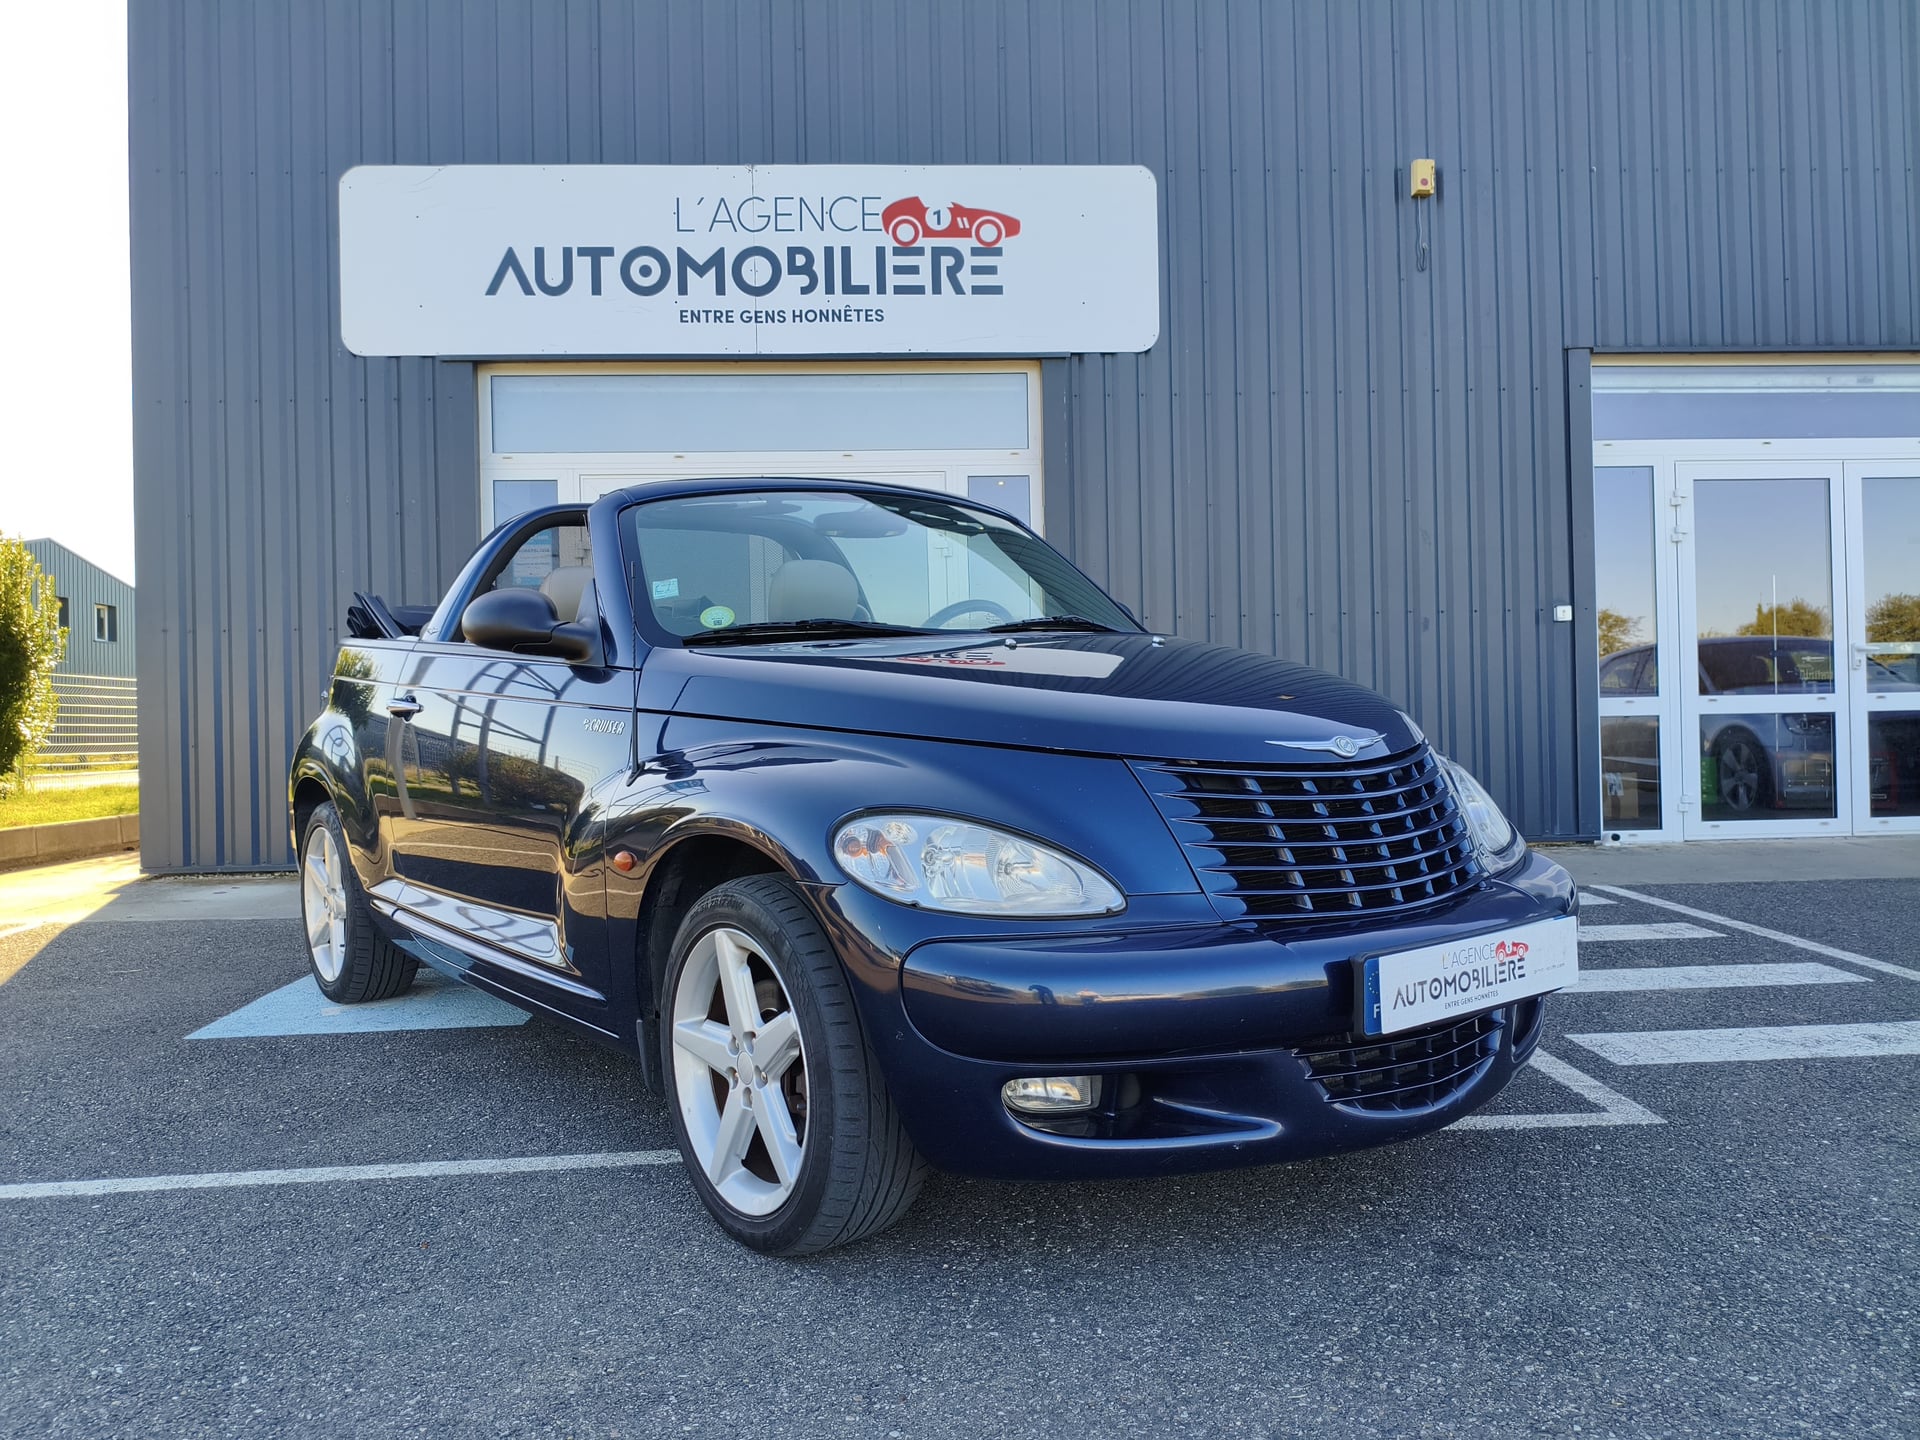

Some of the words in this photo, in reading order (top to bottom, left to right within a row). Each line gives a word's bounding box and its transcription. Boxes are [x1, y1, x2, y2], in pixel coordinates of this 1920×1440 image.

[679, 309, 735, 323] ENTRE
[740, 309, 787, 324] GENS
[792, 304, 885, 323] HONNÊTES
[590, 718, 626, 735] CRUISER
[1444, 1001, 1460, 1009] ENTRE
